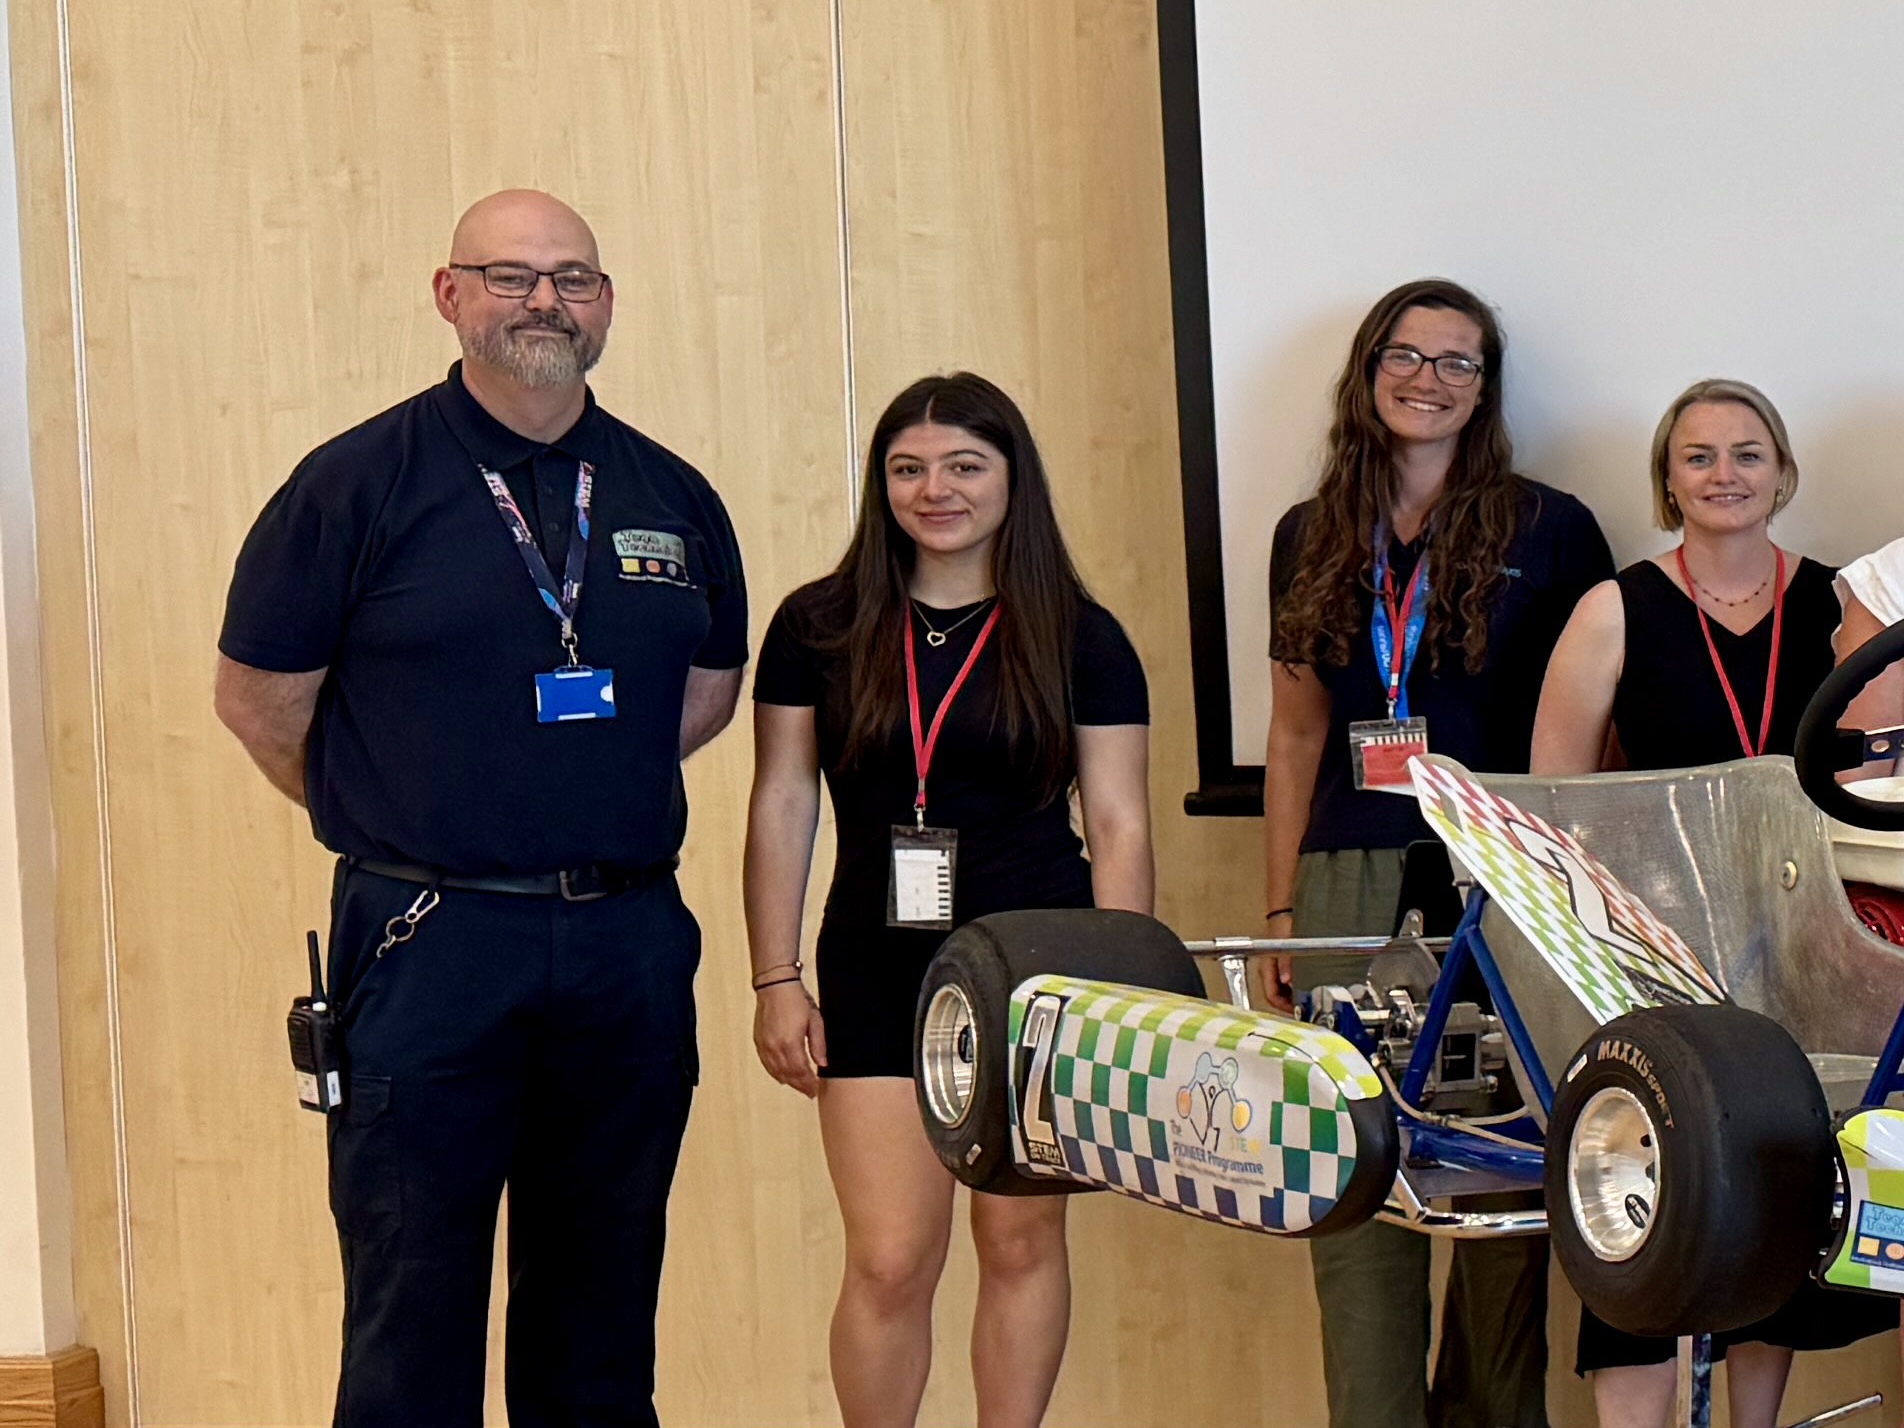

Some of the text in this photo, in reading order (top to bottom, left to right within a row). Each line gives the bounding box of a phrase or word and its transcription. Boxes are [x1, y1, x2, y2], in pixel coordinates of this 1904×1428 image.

[1022, 994, 1061, 1145] 2
[1597, 1039, 1653, 1078] MAXXIS
[1207, 1149, 1264, 1175] Programme
